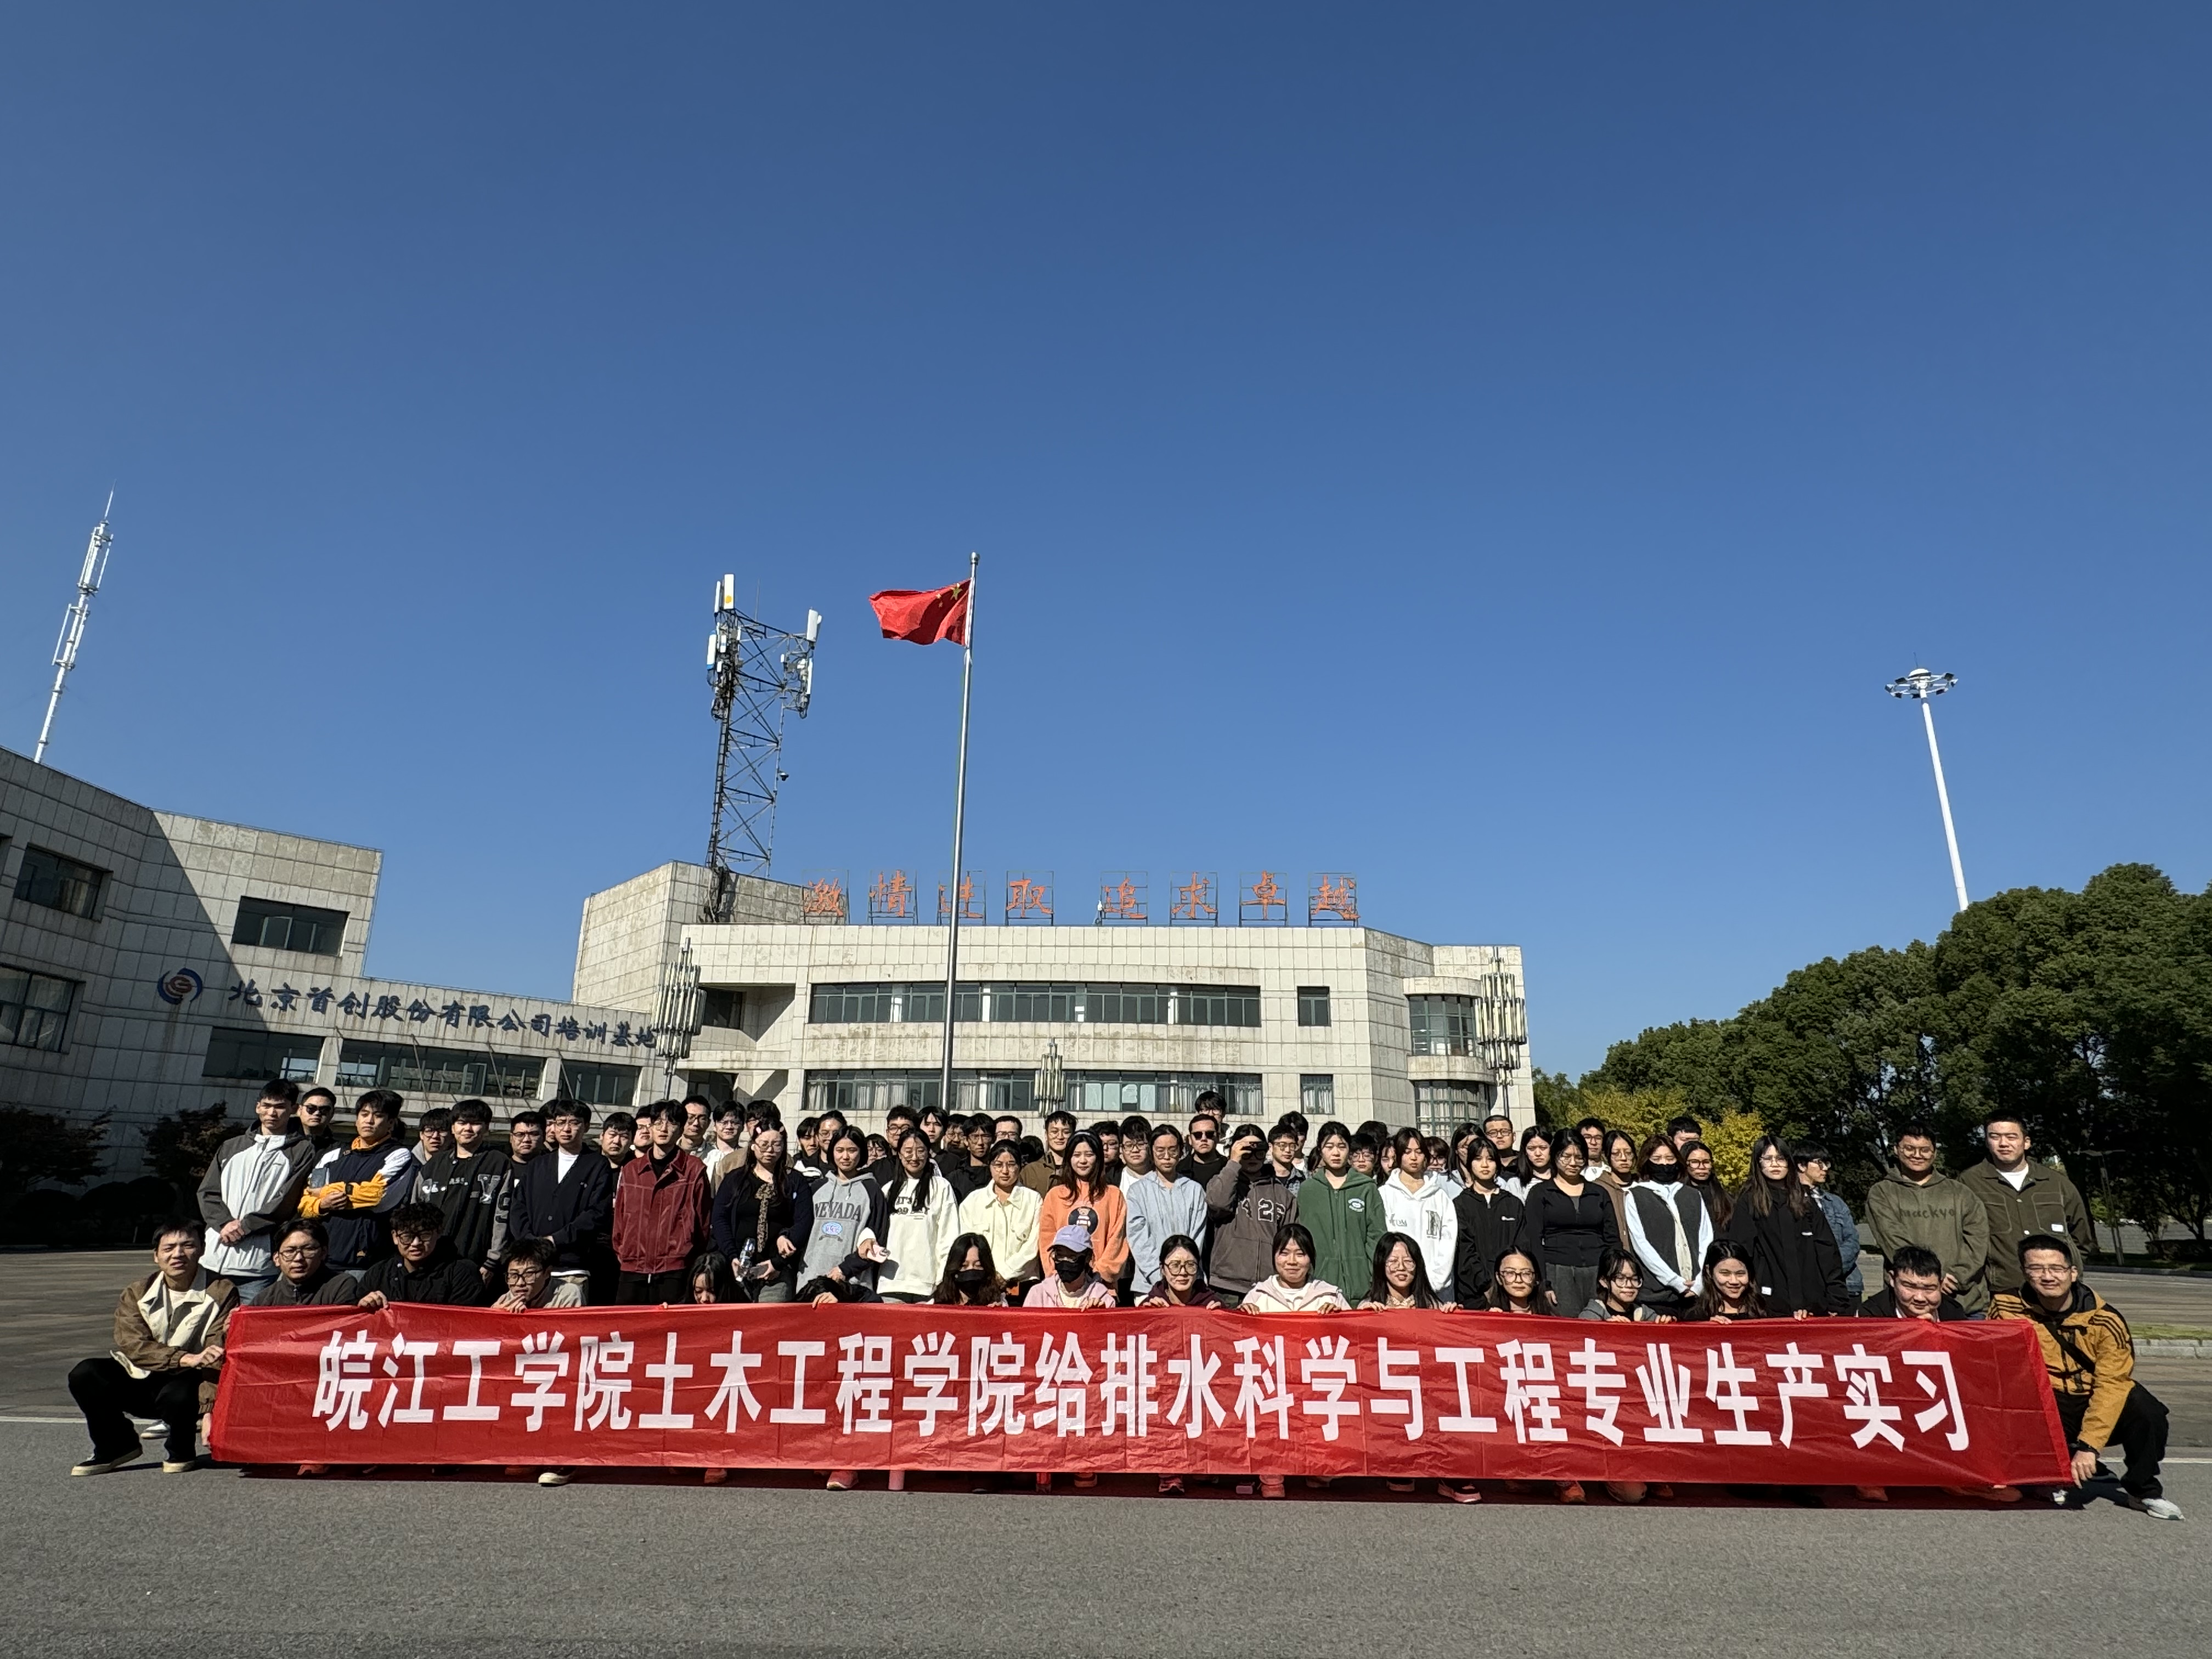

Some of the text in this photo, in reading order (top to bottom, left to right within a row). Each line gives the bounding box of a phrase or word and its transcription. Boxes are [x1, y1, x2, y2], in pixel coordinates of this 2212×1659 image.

[803, 870, 1361, 919] 激情进取 追求卓越
[228, 979, 656, 1048] 北京首创股份有限公司培训基地
[815, 1201, 861, 1221] NEVADA
[312, 1329, 1970, 1452] 皖江工学院土木工程学院给排水科学与工程专业生产实习
